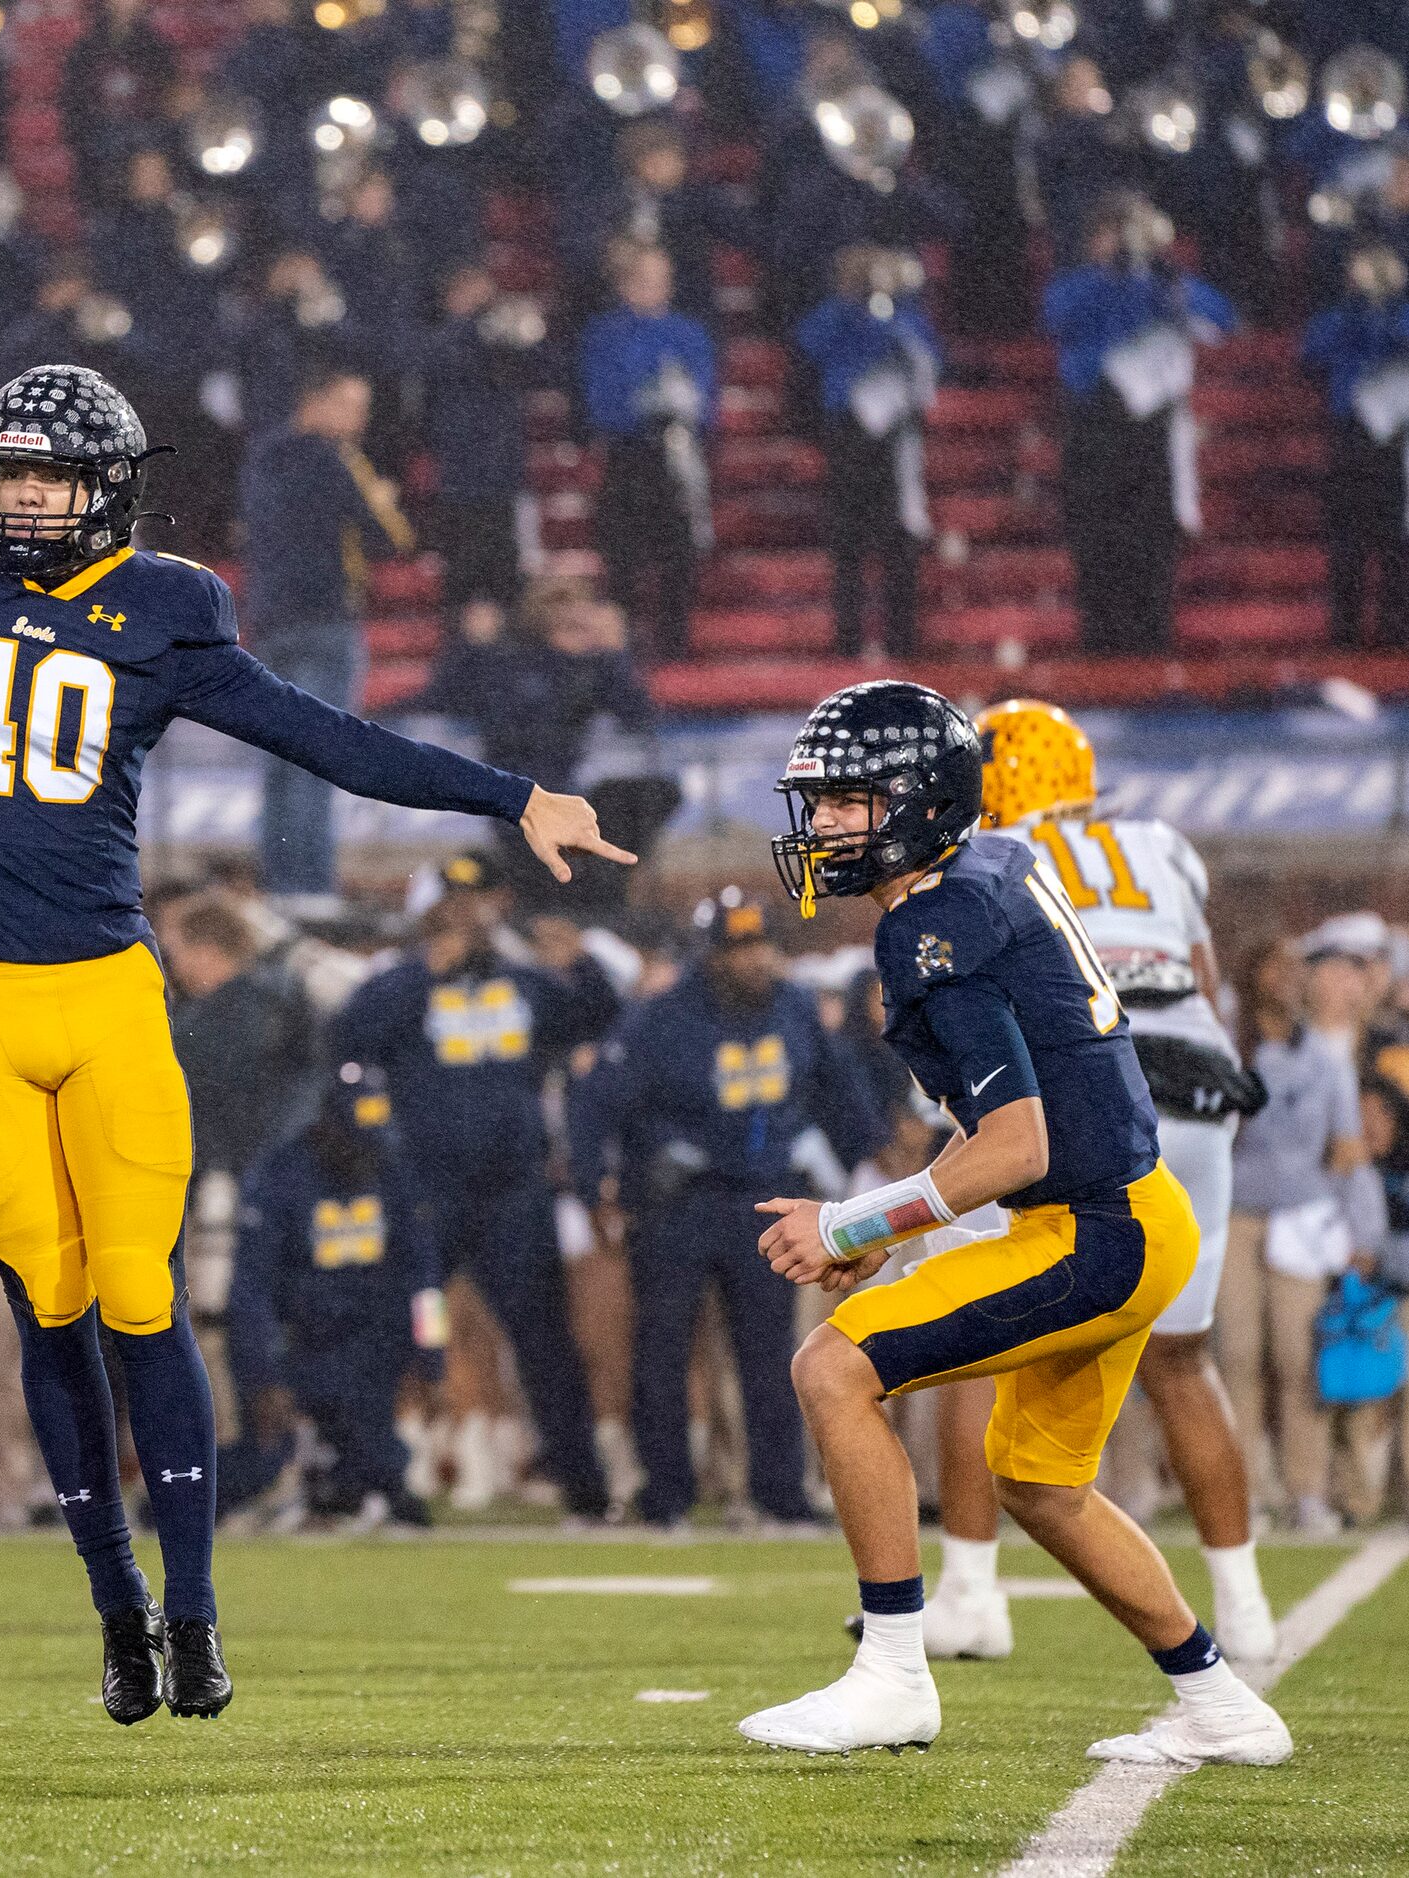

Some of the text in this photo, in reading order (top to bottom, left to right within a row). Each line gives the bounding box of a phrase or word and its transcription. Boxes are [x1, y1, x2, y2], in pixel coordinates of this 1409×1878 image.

[0, 433, 44, 446] Riddell
[11, 616, 56, 643] Scots
[1031, 821, 1153, 911] 11
